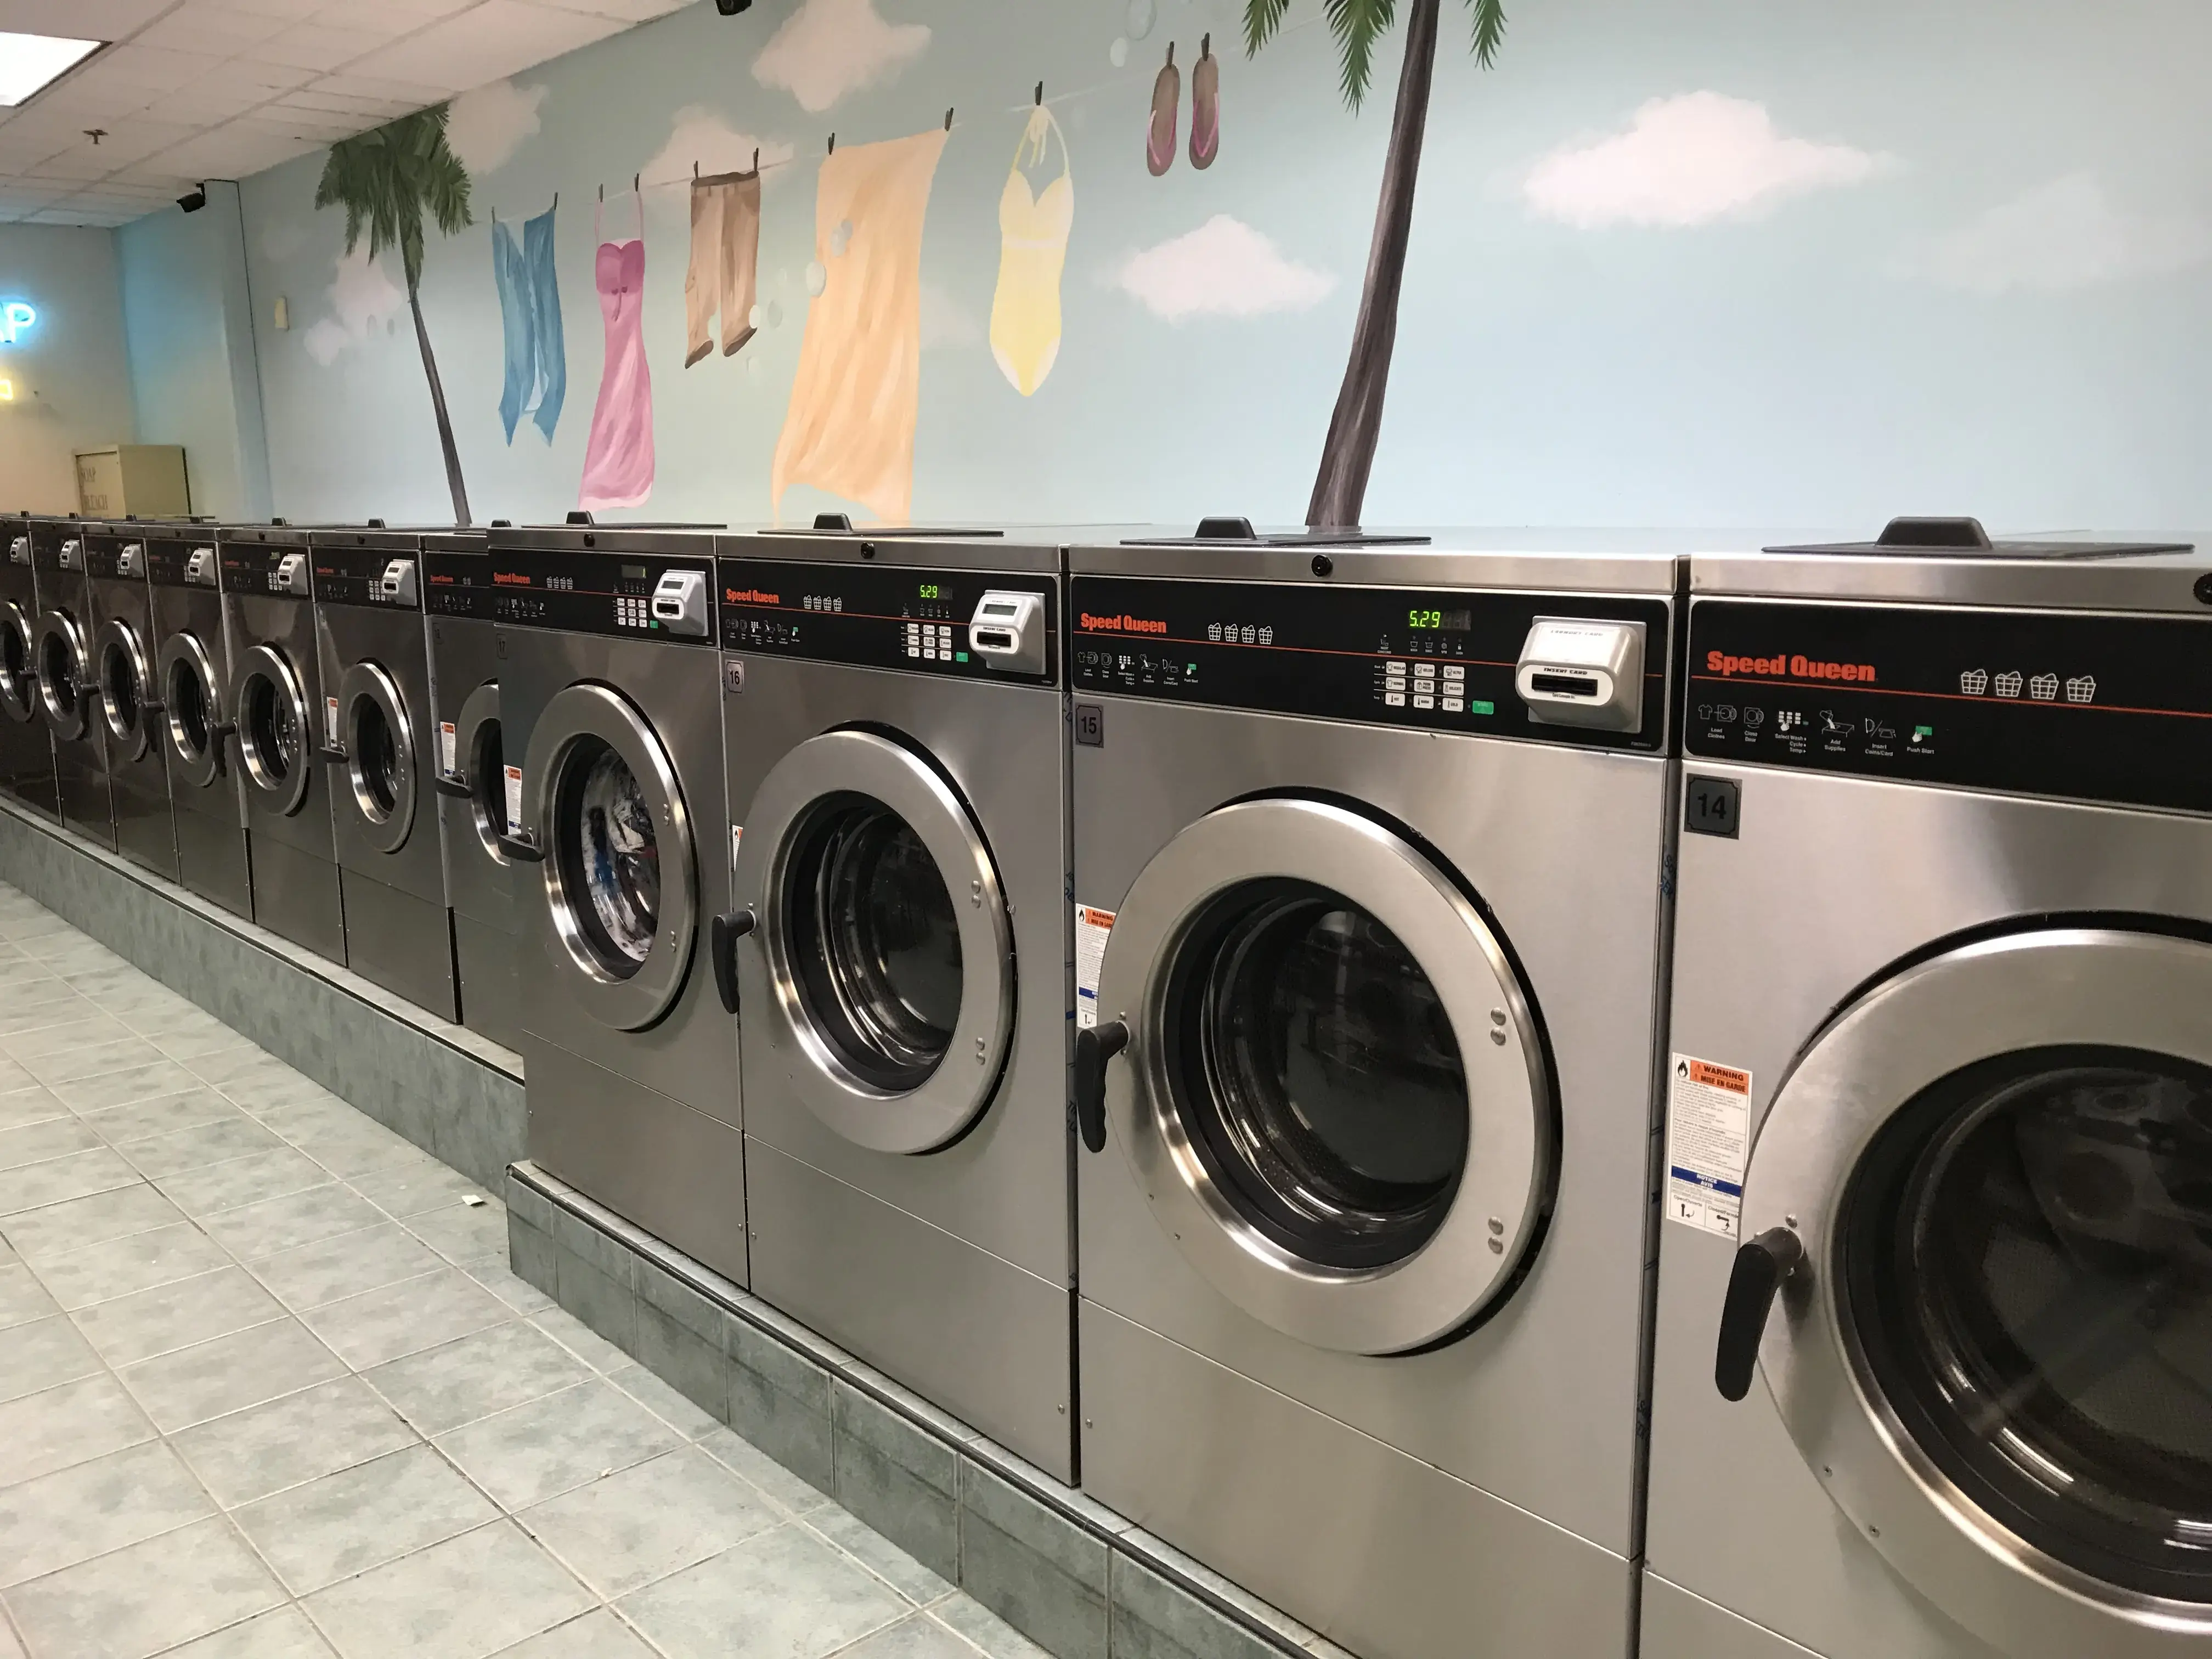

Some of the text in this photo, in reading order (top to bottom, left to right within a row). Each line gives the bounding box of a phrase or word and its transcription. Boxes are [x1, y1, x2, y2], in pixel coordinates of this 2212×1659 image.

[494, 572, 531, 584] Speed Queen
[726, 588, 779, 603] Speed Queen
[1081, 613, 1167, 633] Speed Queen
[1409, 610, 1441, 628] 5.29
[499, 640, 505, 652] 17
[1707, 650, 1876, 682] Speed Queen
[730, 670, 740, 685] 16
[1081, 716, 1097, 734] 15
[1698, 793, 1726, 820] 14
[1092, 911, 1113, 921] WARNING
[1703, 1065, 1743, 1081] WARNING
[1701, 1075, 1746, 1092] MISE EN GARDE
[1696, 1173, 1717, 1184] NOTICE
